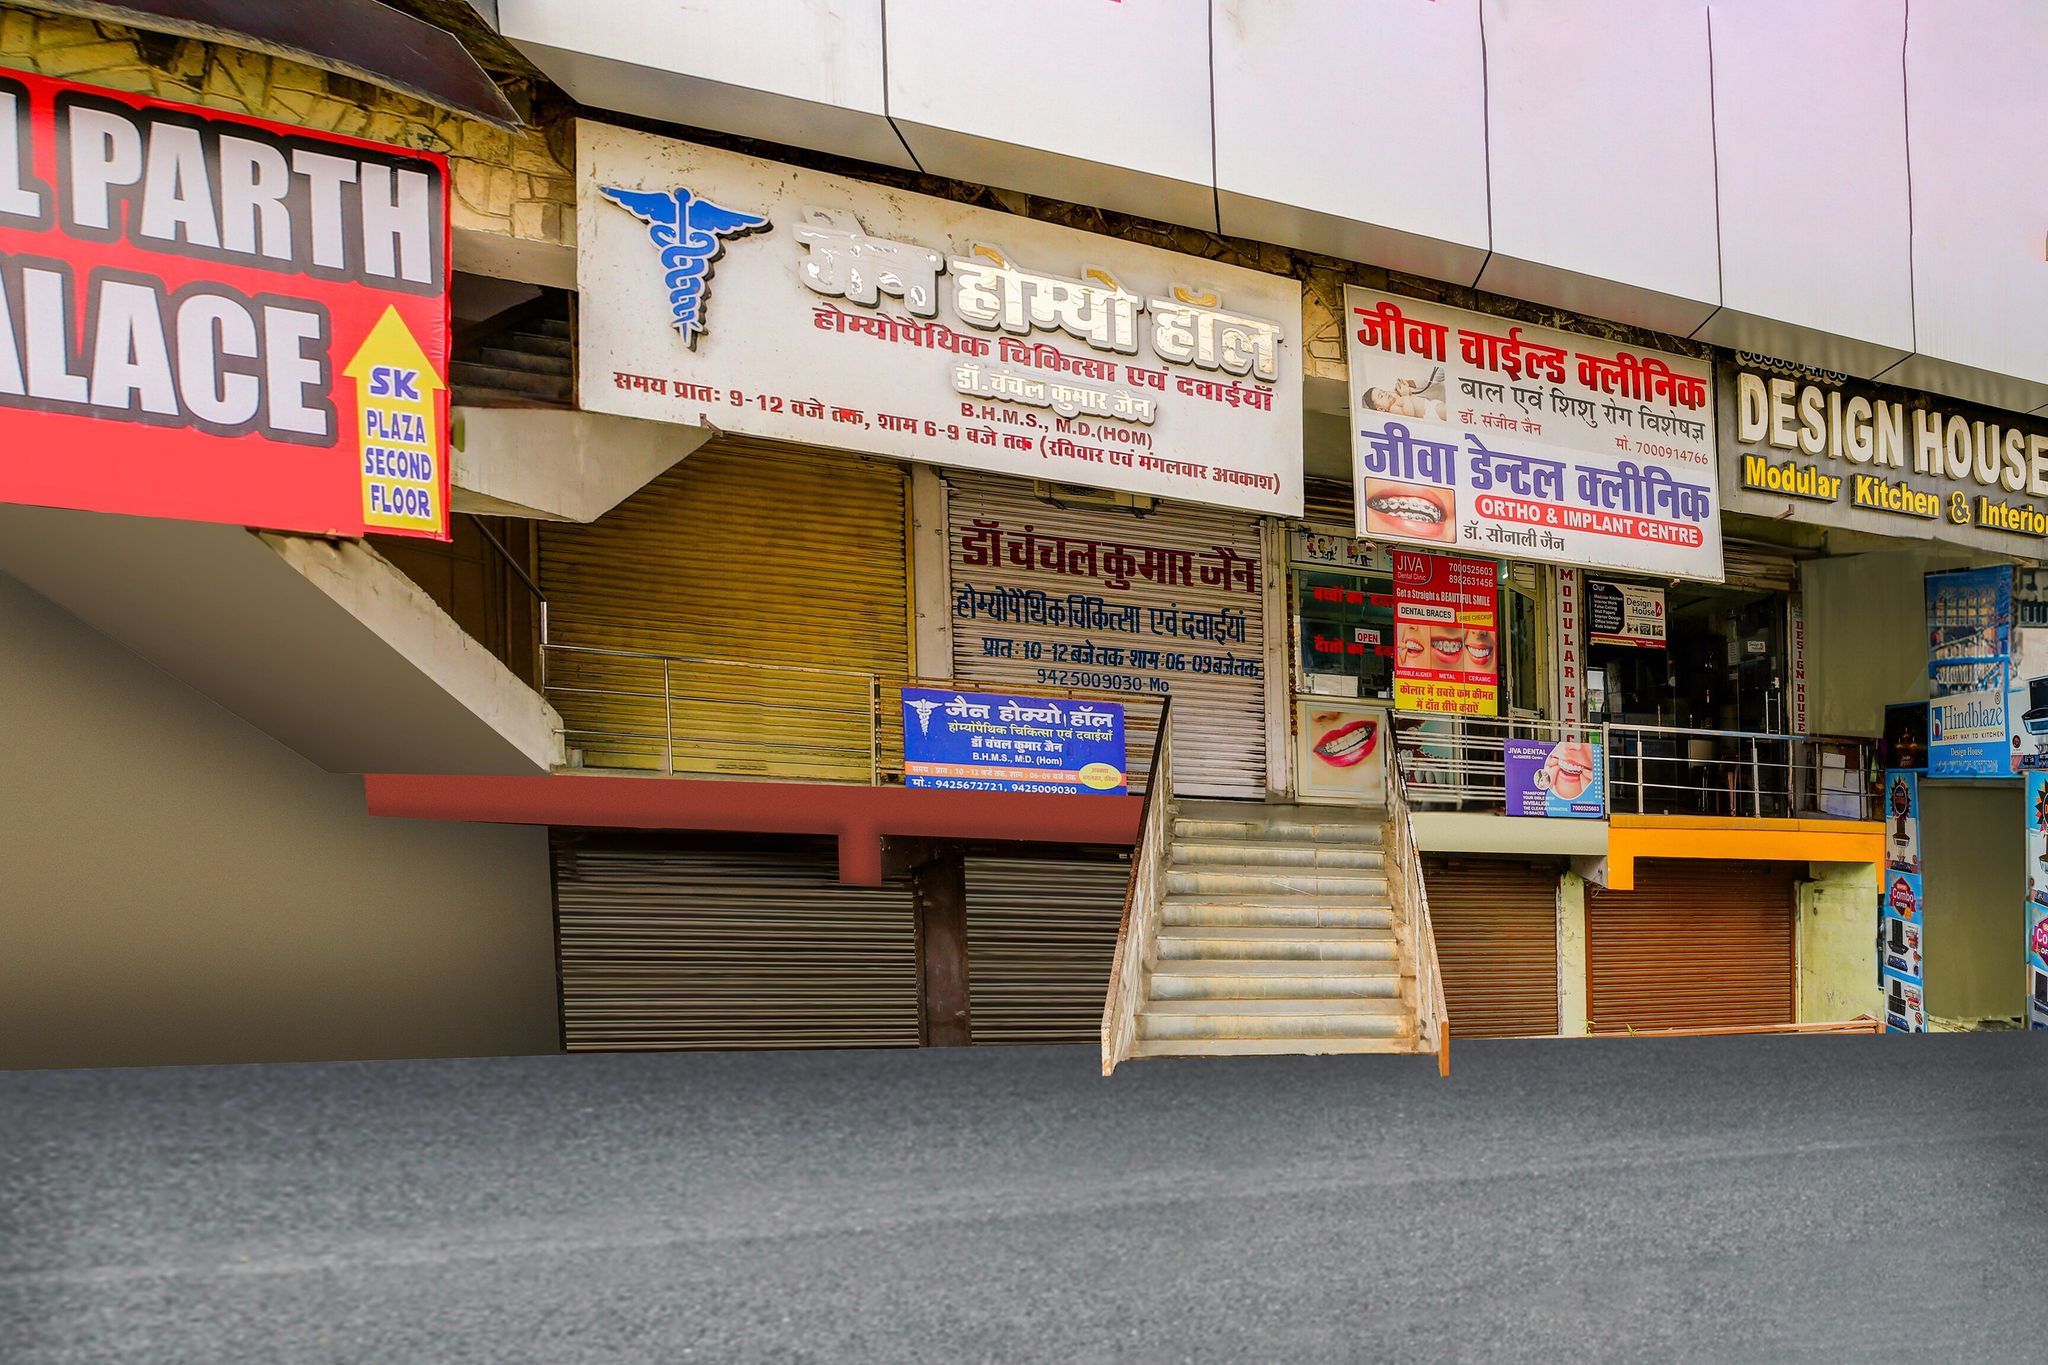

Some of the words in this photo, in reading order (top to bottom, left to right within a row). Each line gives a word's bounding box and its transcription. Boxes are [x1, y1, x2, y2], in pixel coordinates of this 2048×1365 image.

[69, 105, 432, 285] PARTH
[951, 243, 1141, 350] होम्यो
[1151, 287, 1281, 375] हॉल
[811, 302, 991, 357] होम्योपैथिक
[997, 336, 1118, 382] चिकित्सा
[1125, 366, 1169, 391] एवं
[1354, 301, 1449, 362] जीवा
[1458, 327, 1568, 384] चाईल्ड
[1576, 351, 1707, 411] क्लीनिक
[370, 366, 418, 400] SK
[1050, 382, 1109, 410] कुमार
[1113, 390, 1151, 417] जैन
[1458, 377, 1505, 404] बाल
[1511, 384, 1544, 416] एवं
[1550, 387, 1598, 429] शिशु
[1601, 397, 1634, 428] रोग
[1637, 404, 1707, 442] विशेषज्ञ
[366, 409, 426, 444] PLAZA
[613, 371, 668, 396] समय
[730, 389, 783, 414] 9-12
[878, 413, 918, 434] शाम
[924, 420, 960, 441] 6-9
[966, 425, 998, 446] बजे
[1003, 433, 1034, 451] तक
[1108, 449, 1135, 468] एवं
[1138, 452, 1208, 480] मंगलवार
[961, 403, 1048, 432] B.H.M.S.,
[1458, 408, 1477, 426] डॉ.
[1481, 412, 1519, 432] संजीव
[1521, 418, 1543, 437] जैन
[1737, 371, 1905, 469] DESIGN
[1912, 408, 2048, 499] HOUSE
[365, 446, 432, 481] SECOND
[1636, 441, 1709, 465] 7000914766
[1361, 421, 1459, 486] जीवा
[1464, 433, 1567, 502] डेन्टल
[1575, 460, 1711, 523] क्लीनिक
[370, 484, 431, 518] FLOOR
[1746, 455, 1841, 499] Modular
[1857, 475, 1941, 517] Kitchen
[1950, 489, 1972, 526] &
[1463, 520, 1482, 541] डॉ.
[1486, 523, 1538, 548] सोनाली
[1540, 530, 1566, 552] जैन
[1481, 498, 1541, 522] ORTHO
[1546, 507, 1559, 525] &
[1563, 510, 1635, 536] IMPLANT
[1637, 521, 1699, 545] CENTRE
[1006, 525, 1101, 577] चंचल
[1101, 542, 1196, 591] कुमार
[1199, 546, 1258, 593] जैन
[1397, 555, 1424, 573] JIVA
[1448, 563, 1493, 577] 7000525603
[1397, 571, 1412, 580] Dental
[1413, 573, 1426, 582] Clinic
[1396, 587, 1407, 598] Get
[1412, 589, 1435, 603] Straight
[1473, 595, 1491, 607] SMILE
[1626, 598, 1652, 609] Design
[1632, 607, 1656, 616] House
[1147, 602, 1179, 638] एवं
[1401, 606, 1425, 617] DENTAL
[1427, 609, 1452, 619] BRACES
[1559, 568, 1575, 679] MODULAR
[1023, 640, 1069, 663] 10-12
[1357, 632, 1379, 643] OPEN
[1796, 620, 1805, 680] DESIGN
[1037, 668, 1142, 691] 9425009030
[1439, 672, 1456, 680] METAL
[1400, 682, 1426, 696] कोलार
[1427, 684, 1435, 696] में
[1436, 685, 1455, 698] सबसे
[1471, 687, 1494, 701] कीमत
[1416, 697, 1424, 710] में
[945, 695, 990, 720] जैन
[998, 700, 1062, 725] होम्यो
[1069, 706, 1114, 728] हॉल
[1797, 683, 1806, 732] HOUSE
[1943, 700, 2003, 731] Hindblaze
[1009, 724, 1054, 739] चिकित्सा
[1056, 727, 1074, 742] एवं
[1014, 740, 1043, 754] कुमार
[1044, 740, 1064, 753] जैन
[1972, 732, 1979, 740] TO
[1981, 730, 2005, 738] KITCHEN
[1036, 756, 1064, 767] (Hom)
[1522, 748, 1547, 756] DENTAL
[1950, 747, 1967, 757] Design
[1967, 746, 1984, 756] House
[1011, 783, 1077, 795] 9425009030
[1893, 888, 1914, 903] Combo
